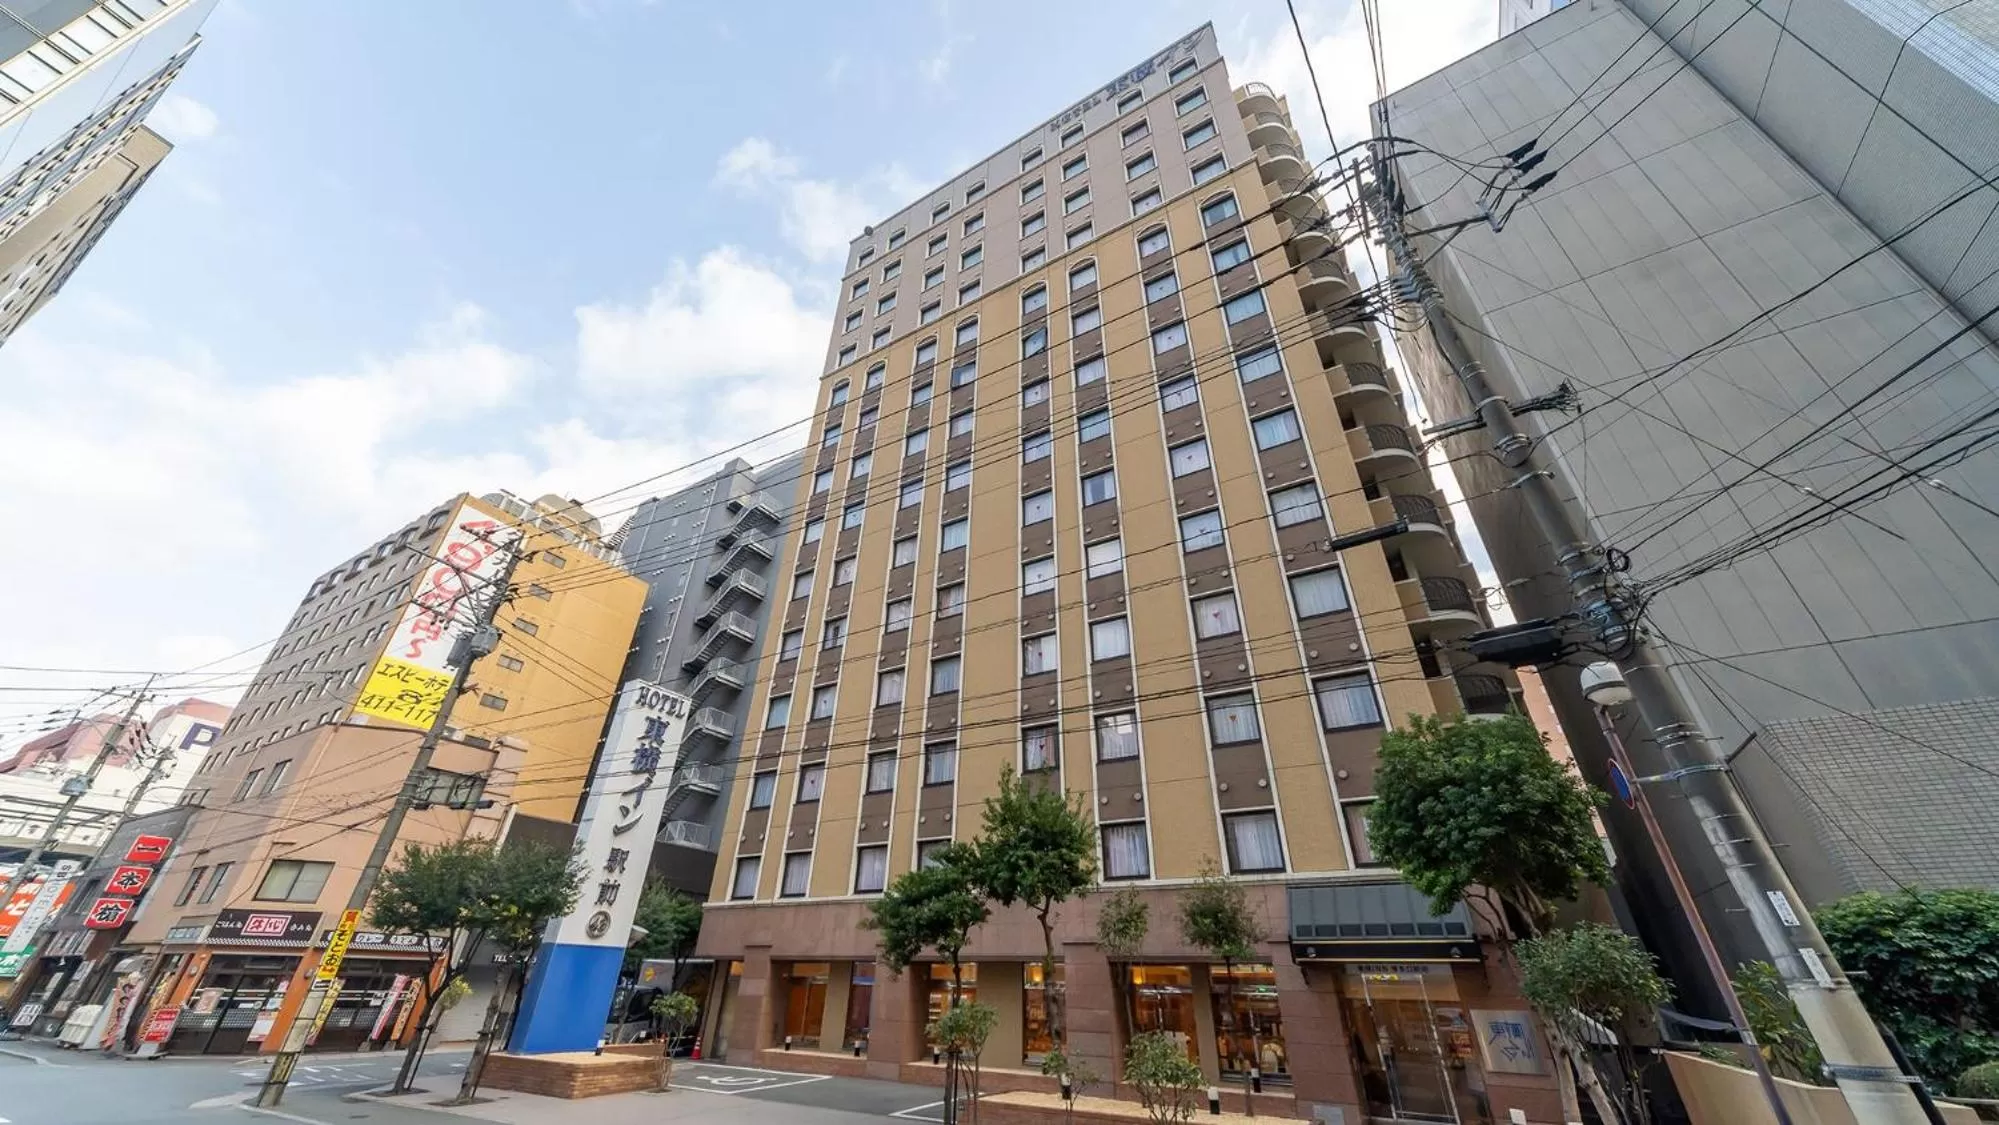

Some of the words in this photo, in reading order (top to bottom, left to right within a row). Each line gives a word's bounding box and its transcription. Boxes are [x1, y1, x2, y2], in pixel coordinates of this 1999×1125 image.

[635, 686, 687, 719] HOTEL
[179, 722, 222, 750] P
[613, 715, 670, 837] 東横イン
[594, 847, 630, 907] 駅前
